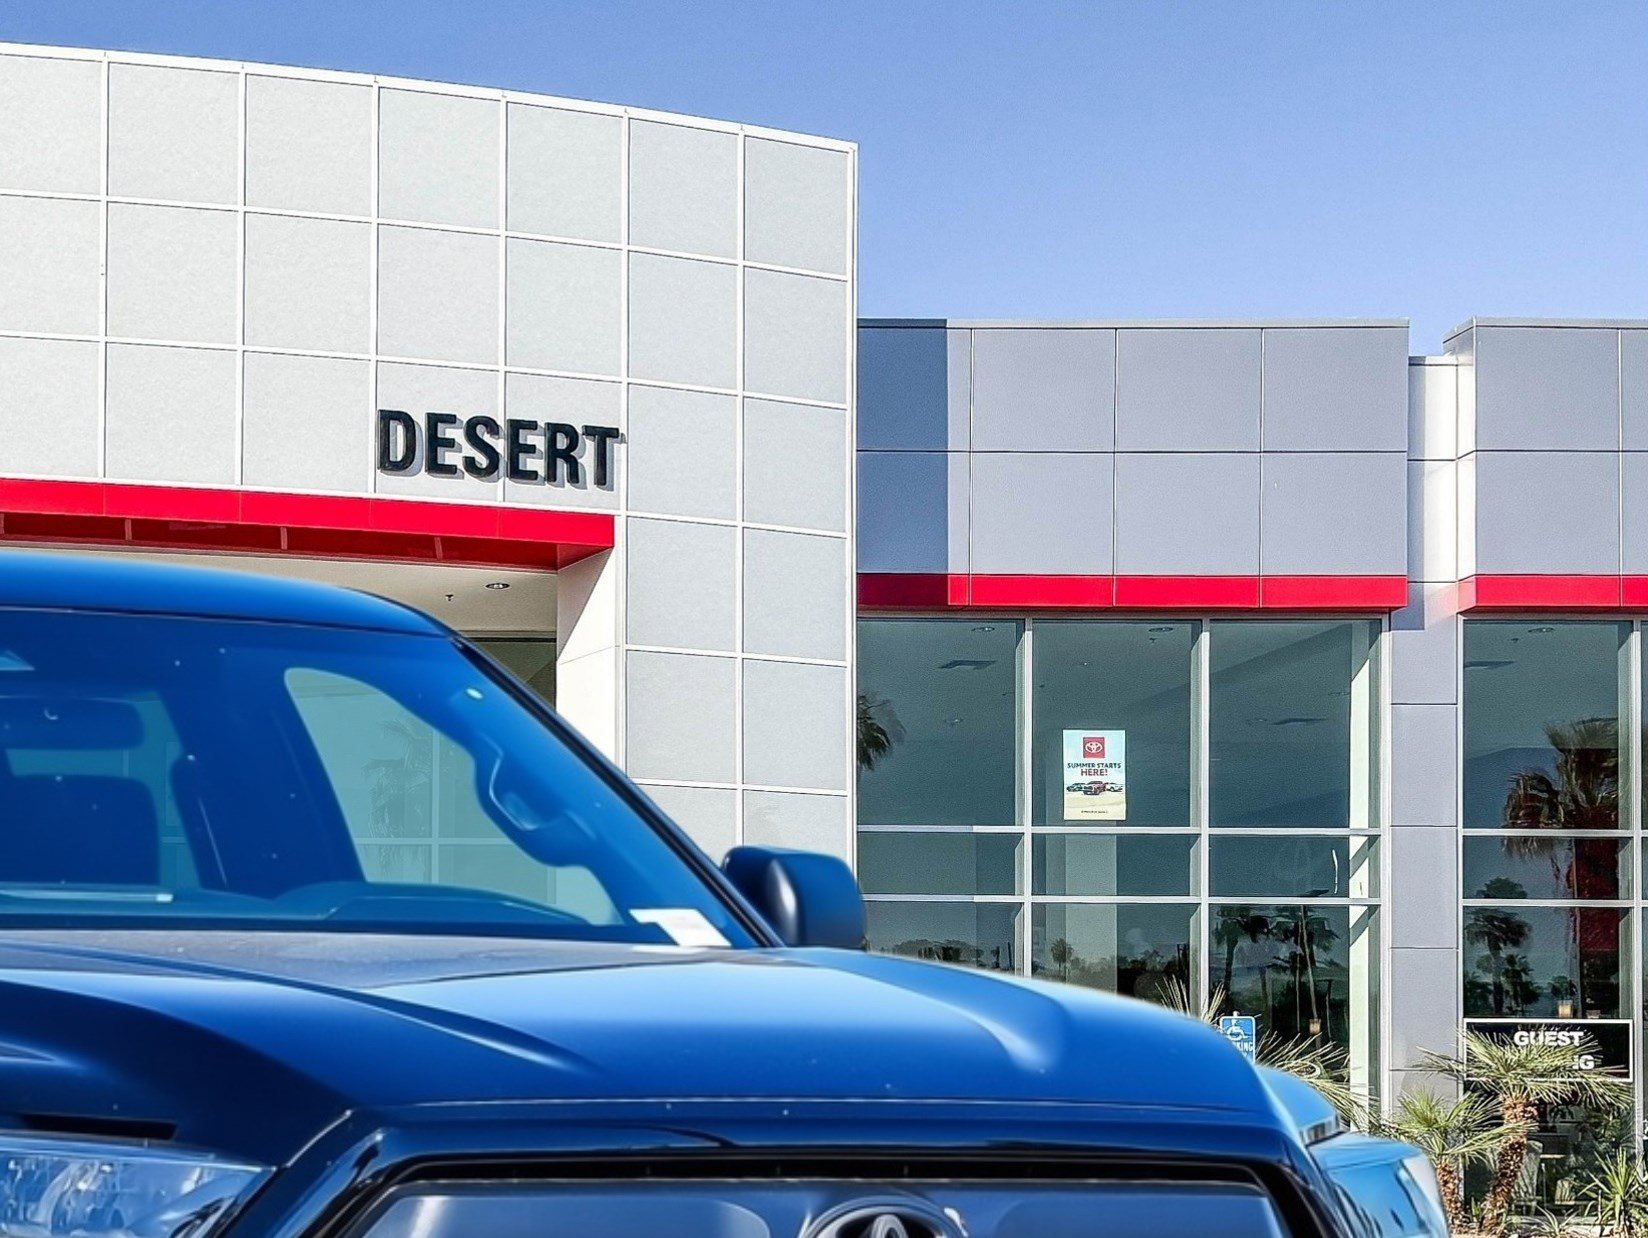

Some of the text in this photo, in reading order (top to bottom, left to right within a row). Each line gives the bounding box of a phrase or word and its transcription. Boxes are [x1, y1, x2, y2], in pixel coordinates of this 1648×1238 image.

[377, 409, 620, 487] DESERT
[1080, 768, 1108, 777] HERE!
[1513, 1030, 1584, 1046] GUEST
